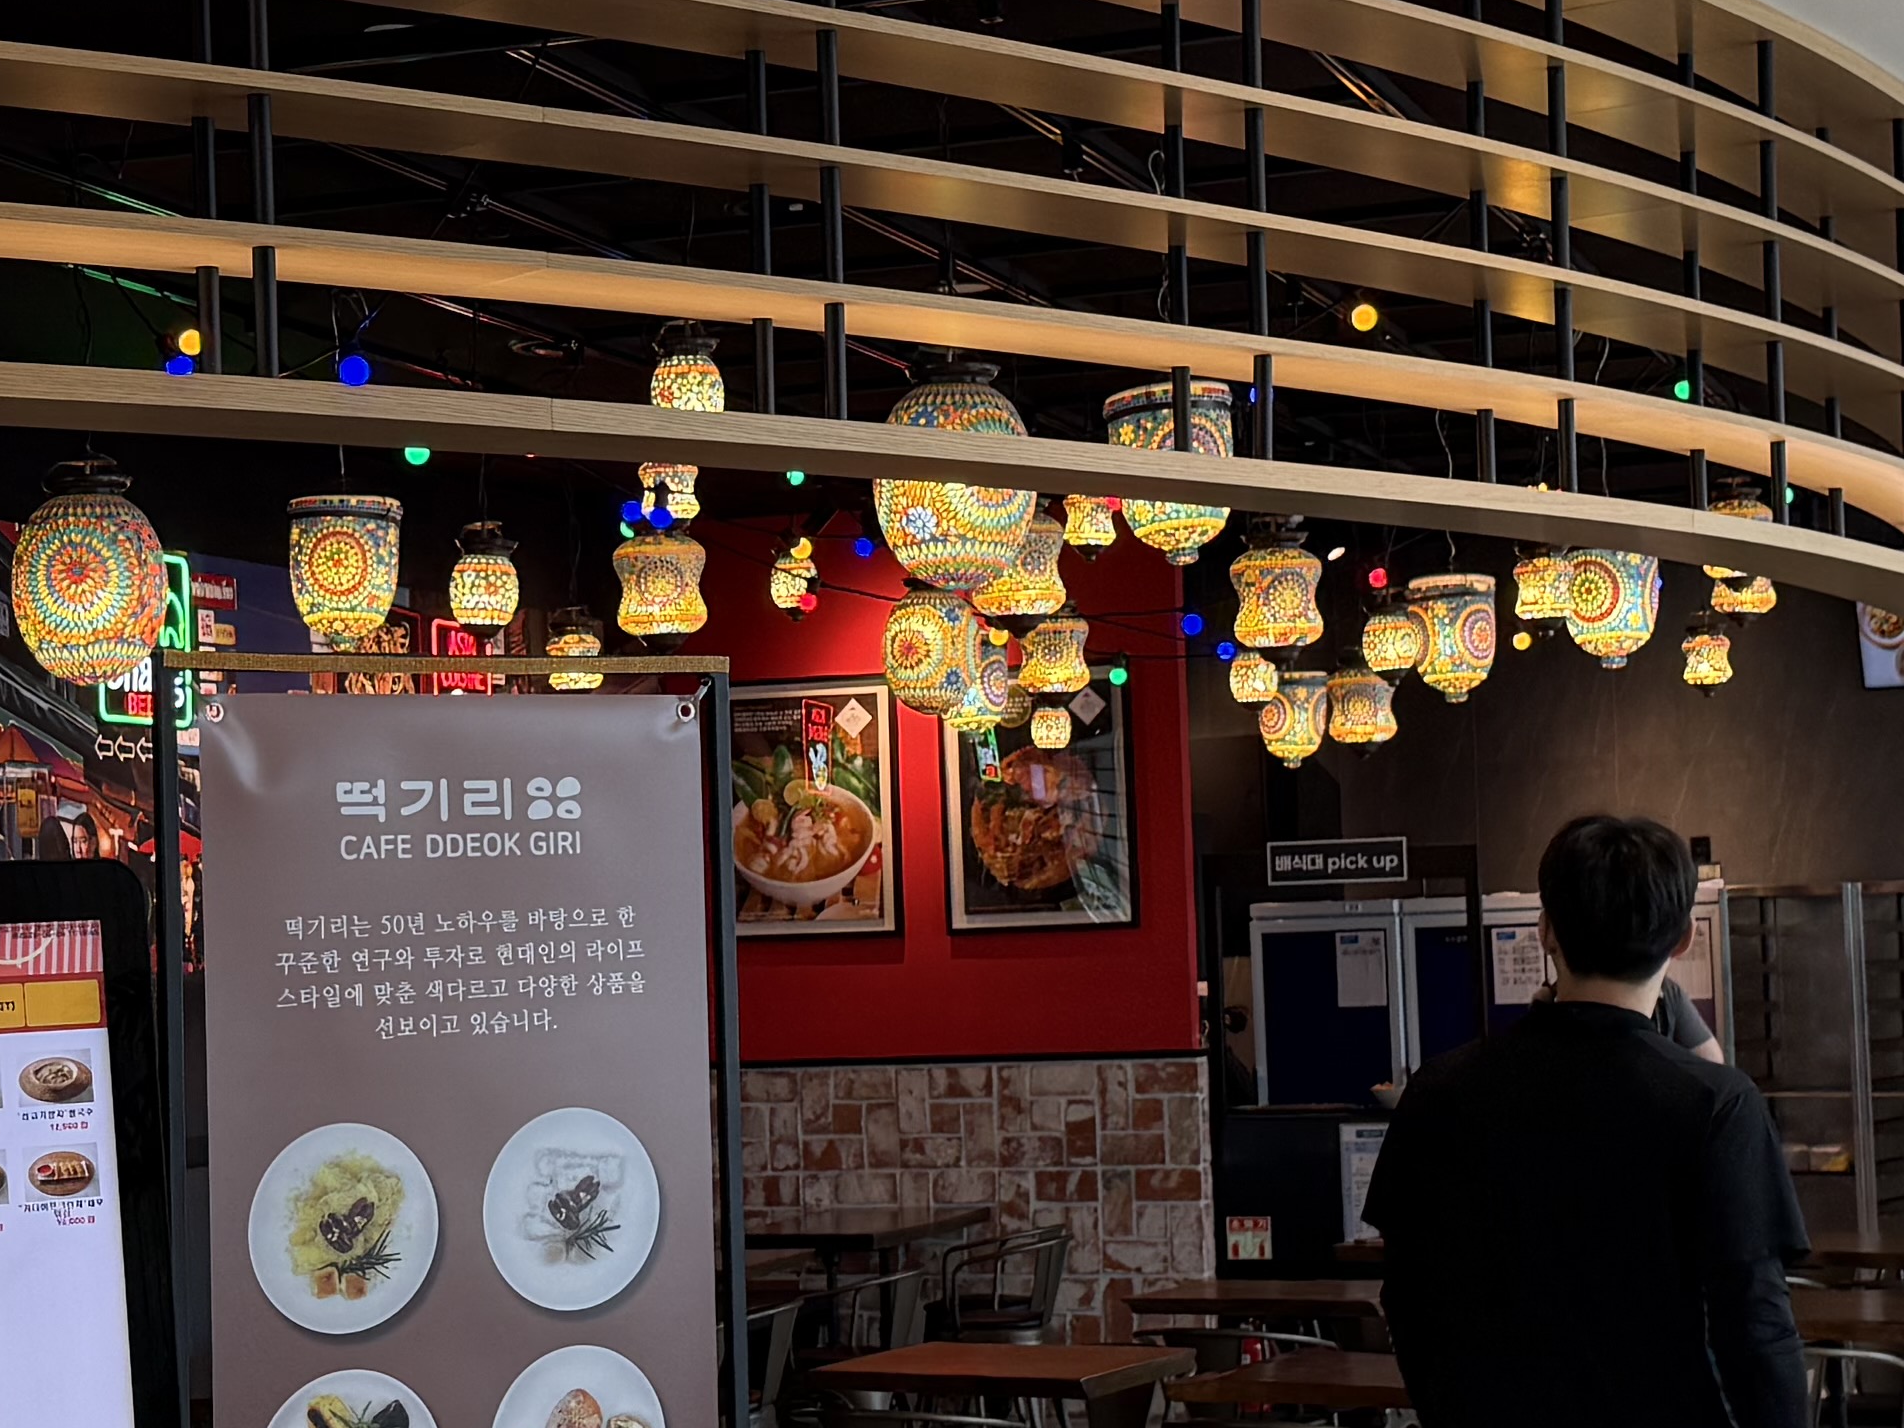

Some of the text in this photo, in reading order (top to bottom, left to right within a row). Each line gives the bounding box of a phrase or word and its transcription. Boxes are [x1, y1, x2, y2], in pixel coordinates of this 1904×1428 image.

[336, 777, 513, 823] 떡기리
[340, 830, 582, 861] CAFE DDEOK GIRI
[1327, 853, 1368, 874] pick
[1373, 853, 1399, 873] up
[285, 904, 637, 941] 떡기리는 50년 노하우를 바탕으로 한
[275, 936, 646, 976] 꾸준한 연구와 투자로 현대인의 라이프
[276, 970, 646, 1011] 스타일에 맞춘 색다르고 다양한 상품을
[375, 1008, 559, 1039] 선보이고 있습니다.
